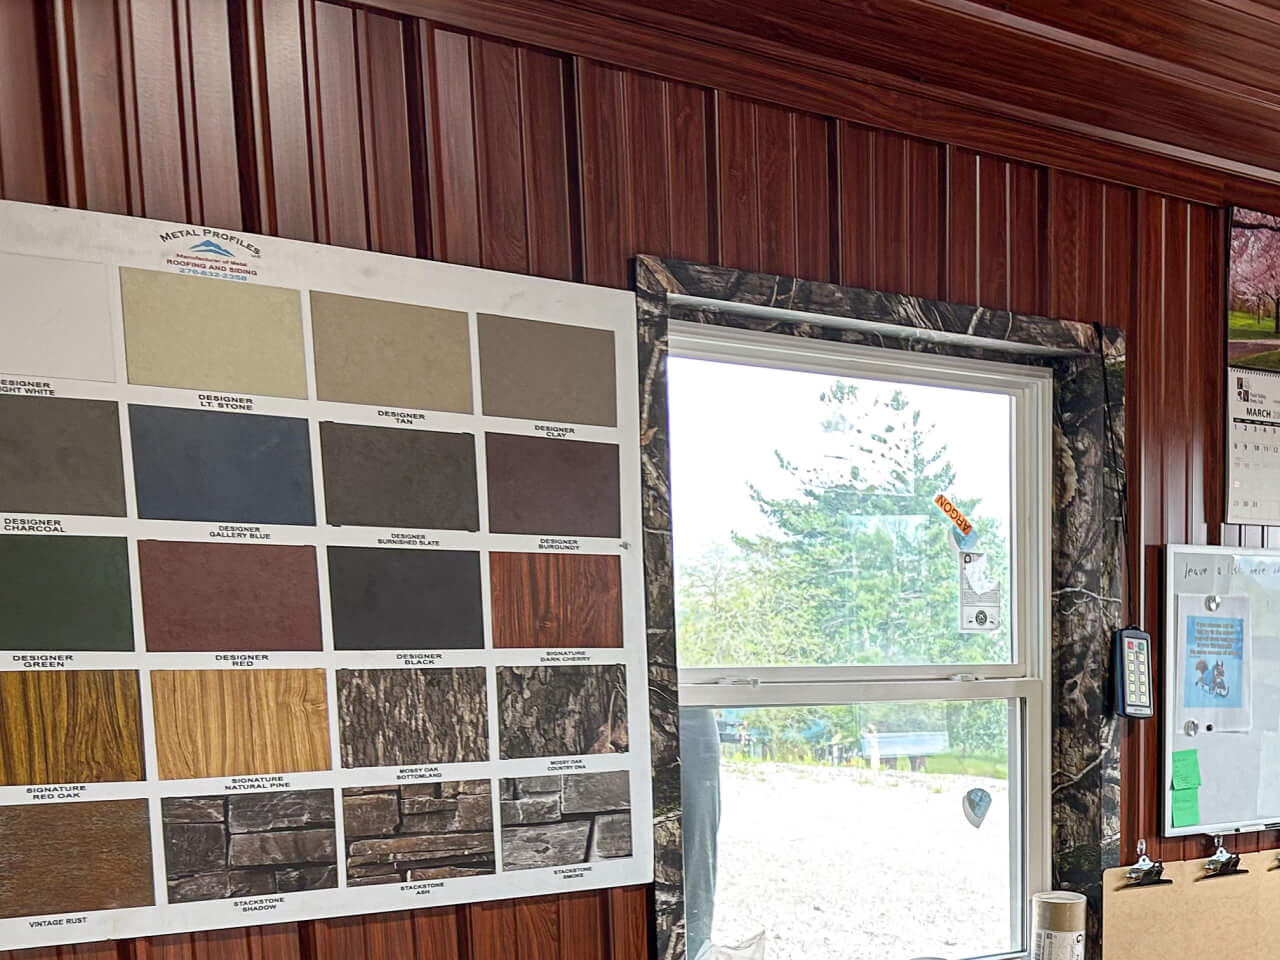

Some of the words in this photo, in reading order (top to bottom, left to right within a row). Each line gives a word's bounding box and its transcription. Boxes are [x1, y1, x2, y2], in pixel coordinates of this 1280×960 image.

[160, 229, 200, 243] METAL
[202, 229, 261, 254] PROFILES
[166, 259, 207, 269] ROOFING
[208, 264, 227, 272] AND
[229, 267, 257, 276] SIDING
[0, 379, 51, 389] ESIGNER
[24, 387, 56, 396] WHITE
[198, 394, 253, 404] DESIGNER
[217, 402, 253, 410] STONE
[377, 410, 425, 420] DESIGNER
[1246, 408, 1271, 419] MARCH
[395, 417, 413, 425] TAN
[534, 424, 575, 434] DESIGNER
[935, 496, 972, 532] ARGON
[4, 518, 62, 526] DESIGNER
[4, 525, 65, 533] CHARCOAL
[218, 525, 260, 533] DESIGNER
[209, 531, 247, 539] GALLERY
[231, 776, 284, 784] SIGNATURE
[26, 785, 87, 794] SIGNATURE
[224, 783, 268, 791] NATURAL
[400, 882, 444, 891] STACKSTONE
[233, 897, 285, 907] STACKSTONE
[242, 904, 277, 912] SHADOW
[29, 919, 64, 928] VINTAGE
[65, 916, 88, 924] RUST
